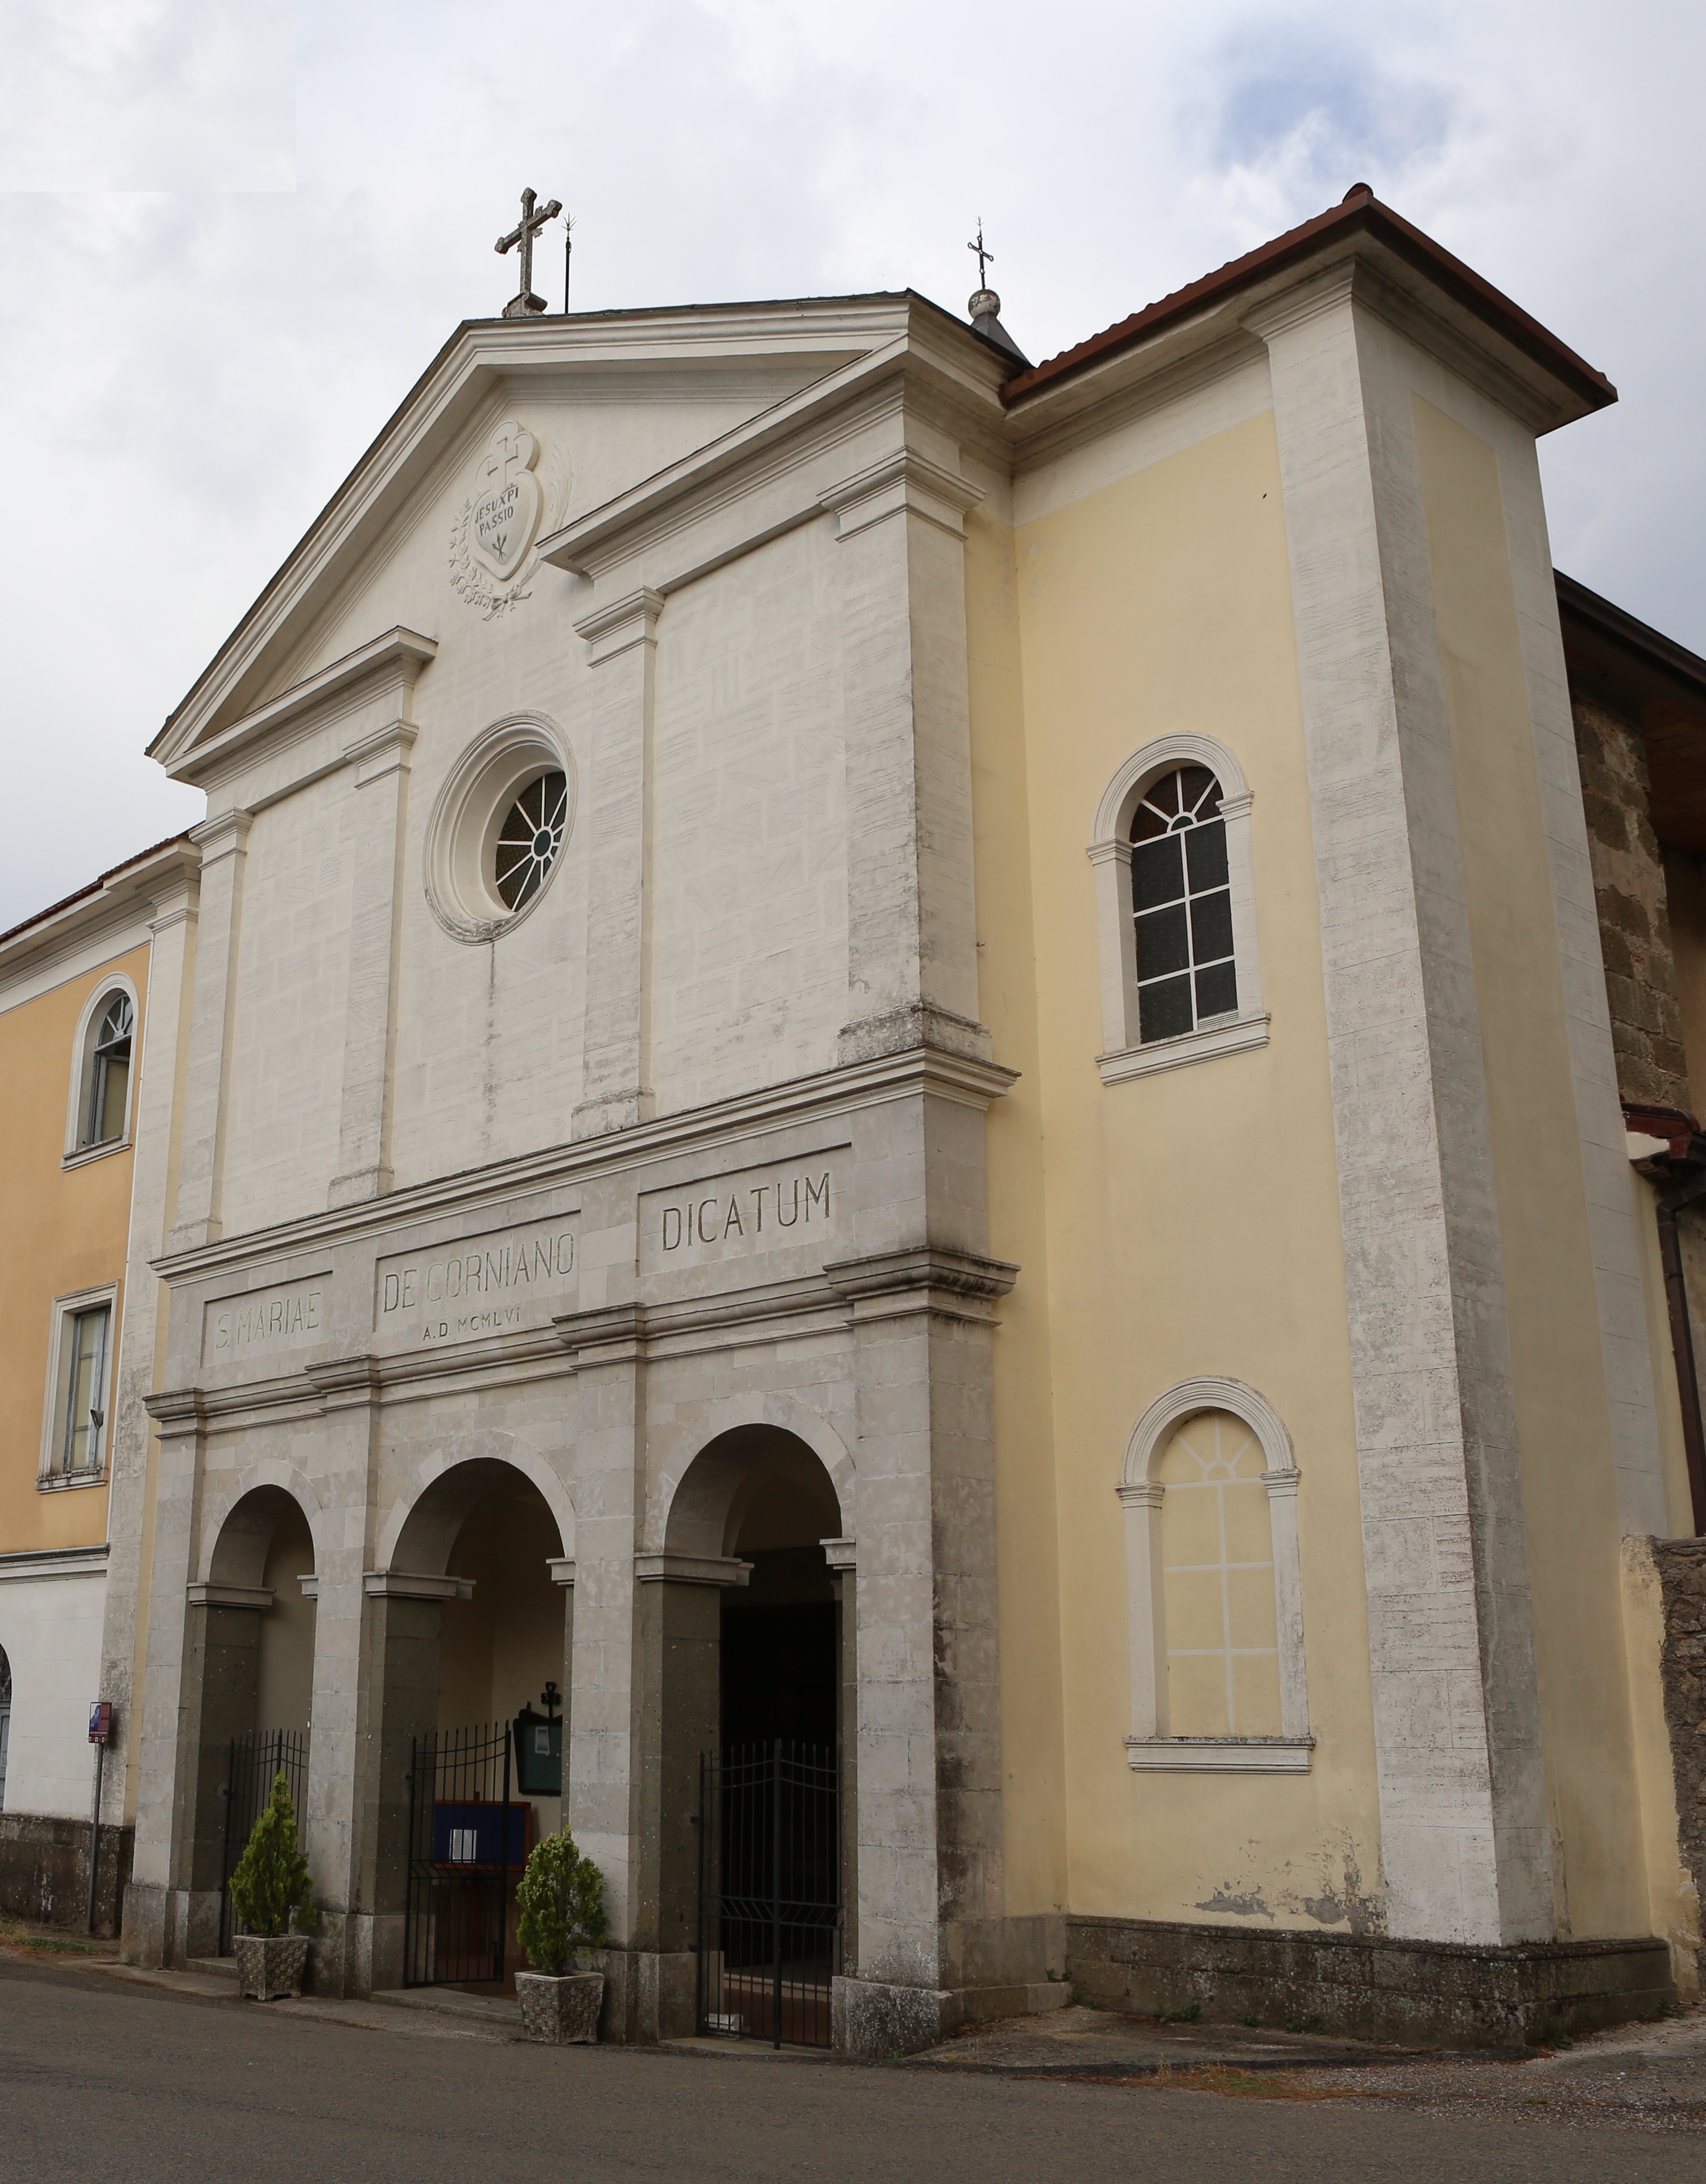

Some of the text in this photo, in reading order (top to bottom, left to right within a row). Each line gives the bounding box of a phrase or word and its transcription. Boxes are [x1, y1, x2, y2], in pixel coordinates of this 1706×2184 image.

[479, 506, 514, 537] PASSIO
[662, 1172, 830, 1252] DICATUM
[383, 1232, 574, 1313] DE CORNIANO
[216, 1292, 321, 1350] S. MARIAE
[457, 1308, 520, 1333] MCMLVI
